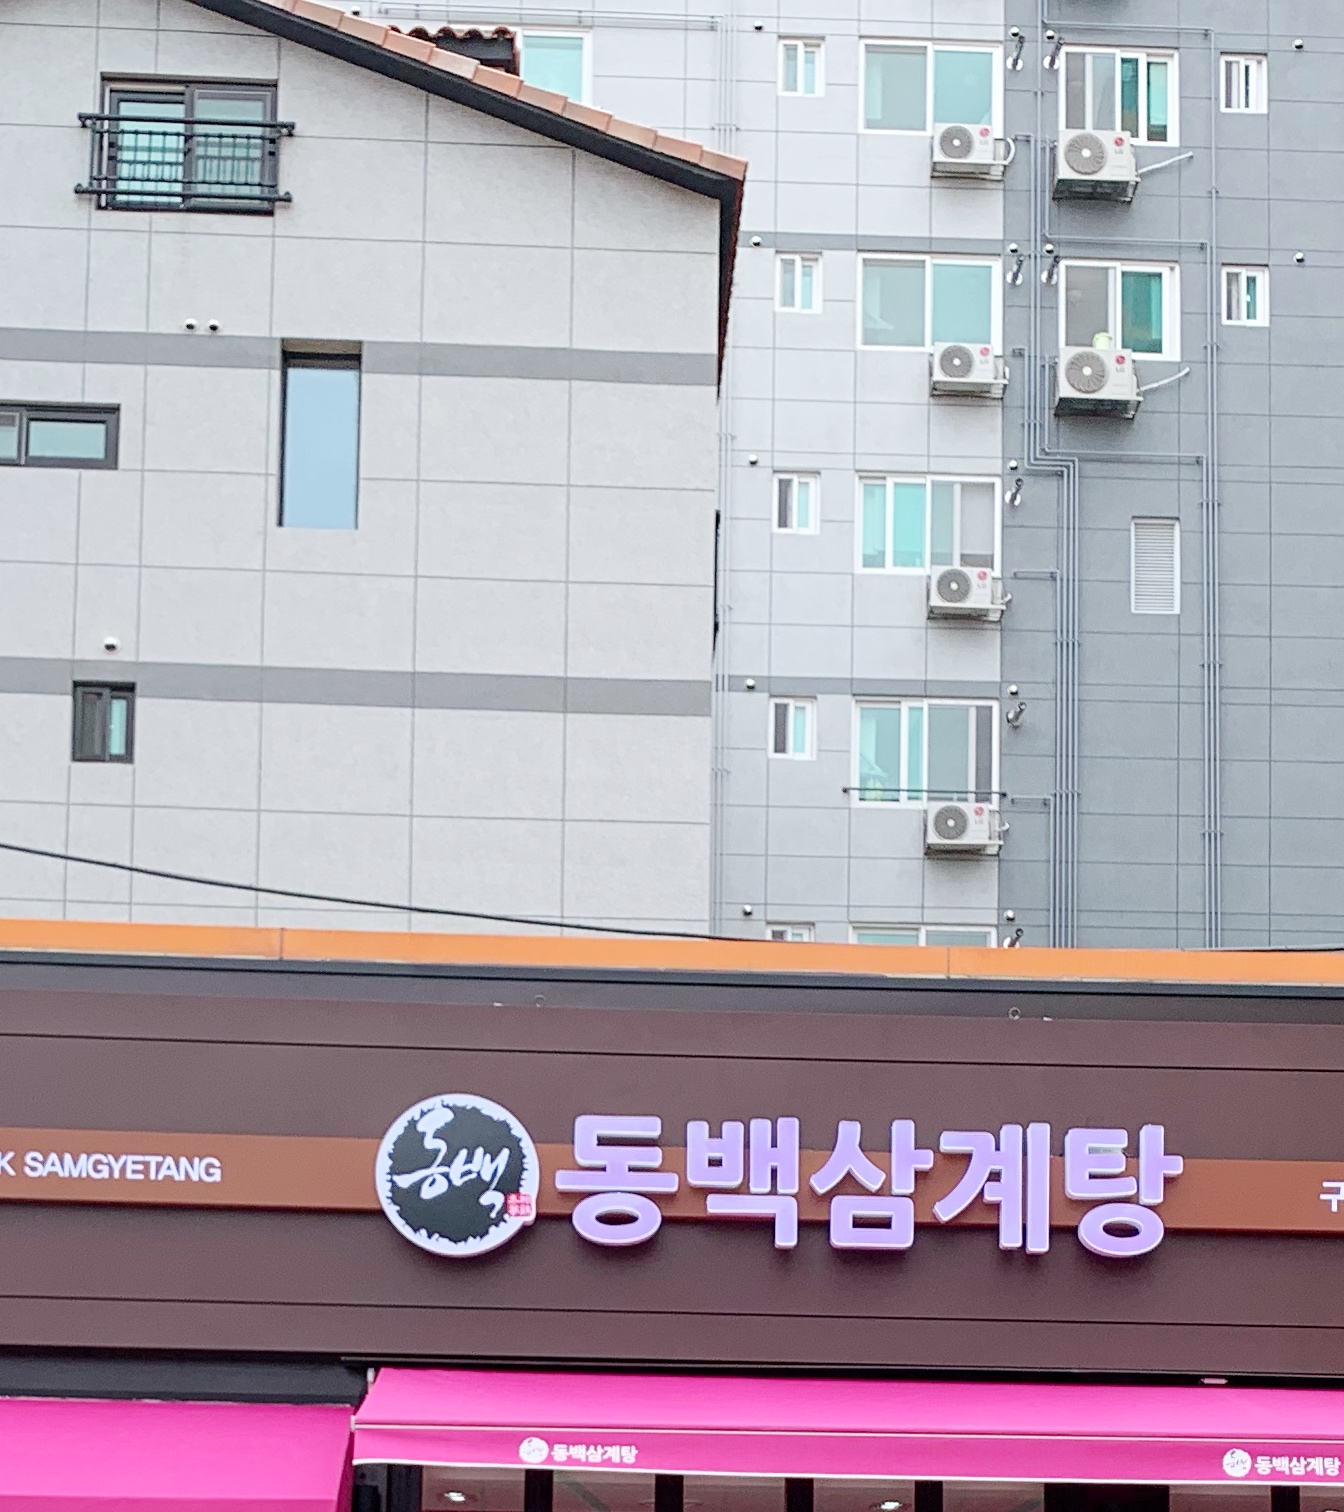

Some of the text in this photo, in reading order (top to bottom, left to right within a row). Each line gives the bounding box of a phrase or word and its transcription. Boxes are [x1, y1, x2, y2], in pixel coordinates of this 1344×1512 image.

[23, 1151, 222, 1183] SAMGYETANG
[555, 1114, 1184, 1258] 동백삼계탕
[551, 1443, 639, 1465] 동백삼계탕
[1254, 1456, 1342, 1477] 동백삼계탕
